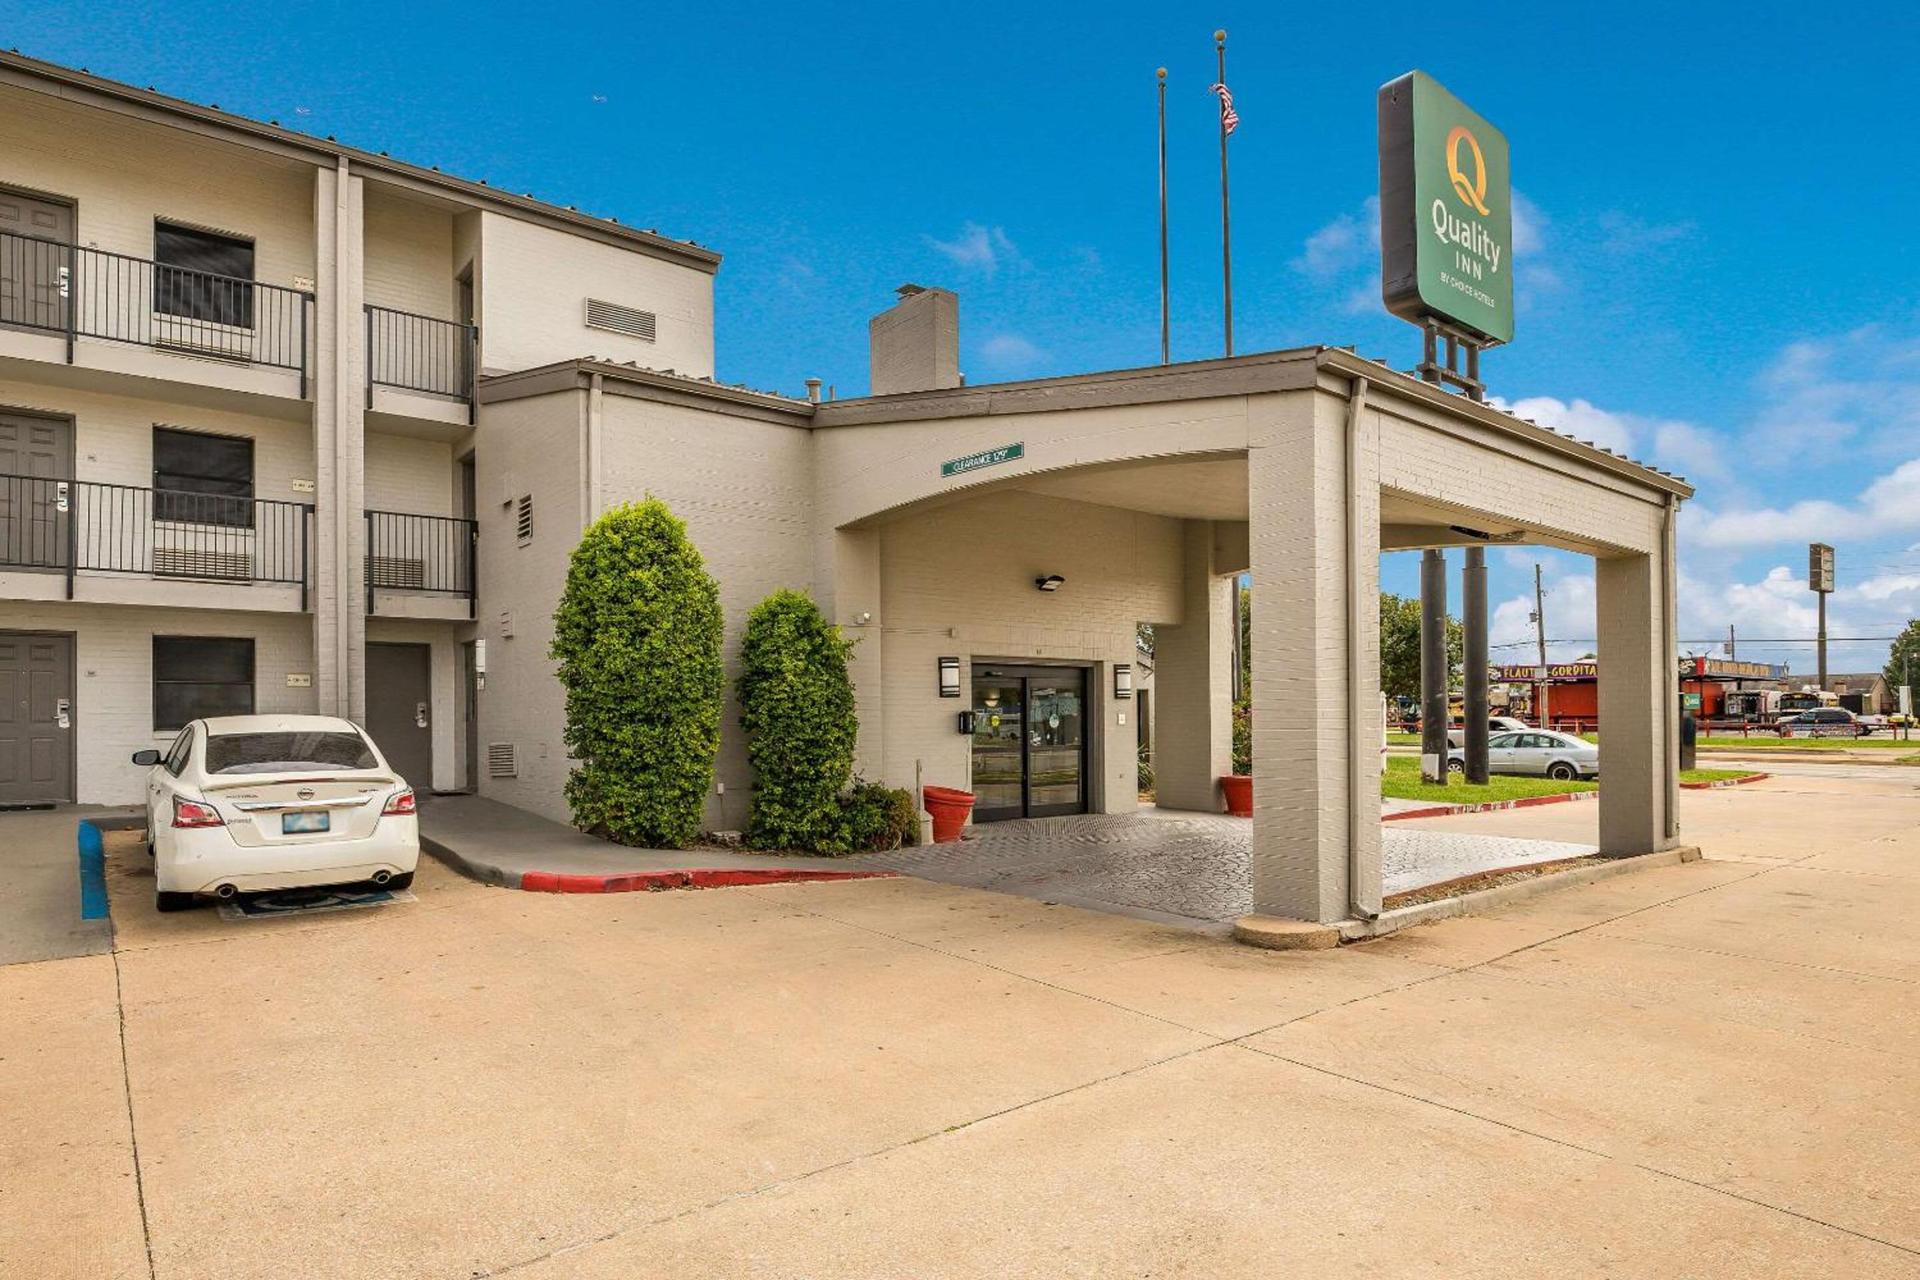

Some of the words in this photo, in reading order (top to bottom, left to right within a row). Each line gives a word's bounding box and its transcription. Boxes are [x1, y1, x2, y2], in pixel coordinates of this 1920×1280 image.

[1432, 198, 1501, 273] Quality
[1456, 250, 1482, 281] INN
[1440, 271, 1450, 284] BY
[1450, 276, 1473, 297] CHOICE
[1473, 289, 1496, 309] HOTELS
[953, 453, 992, 472] CLEARANCE
[1503, 666, 1536, 678] FLAUT
